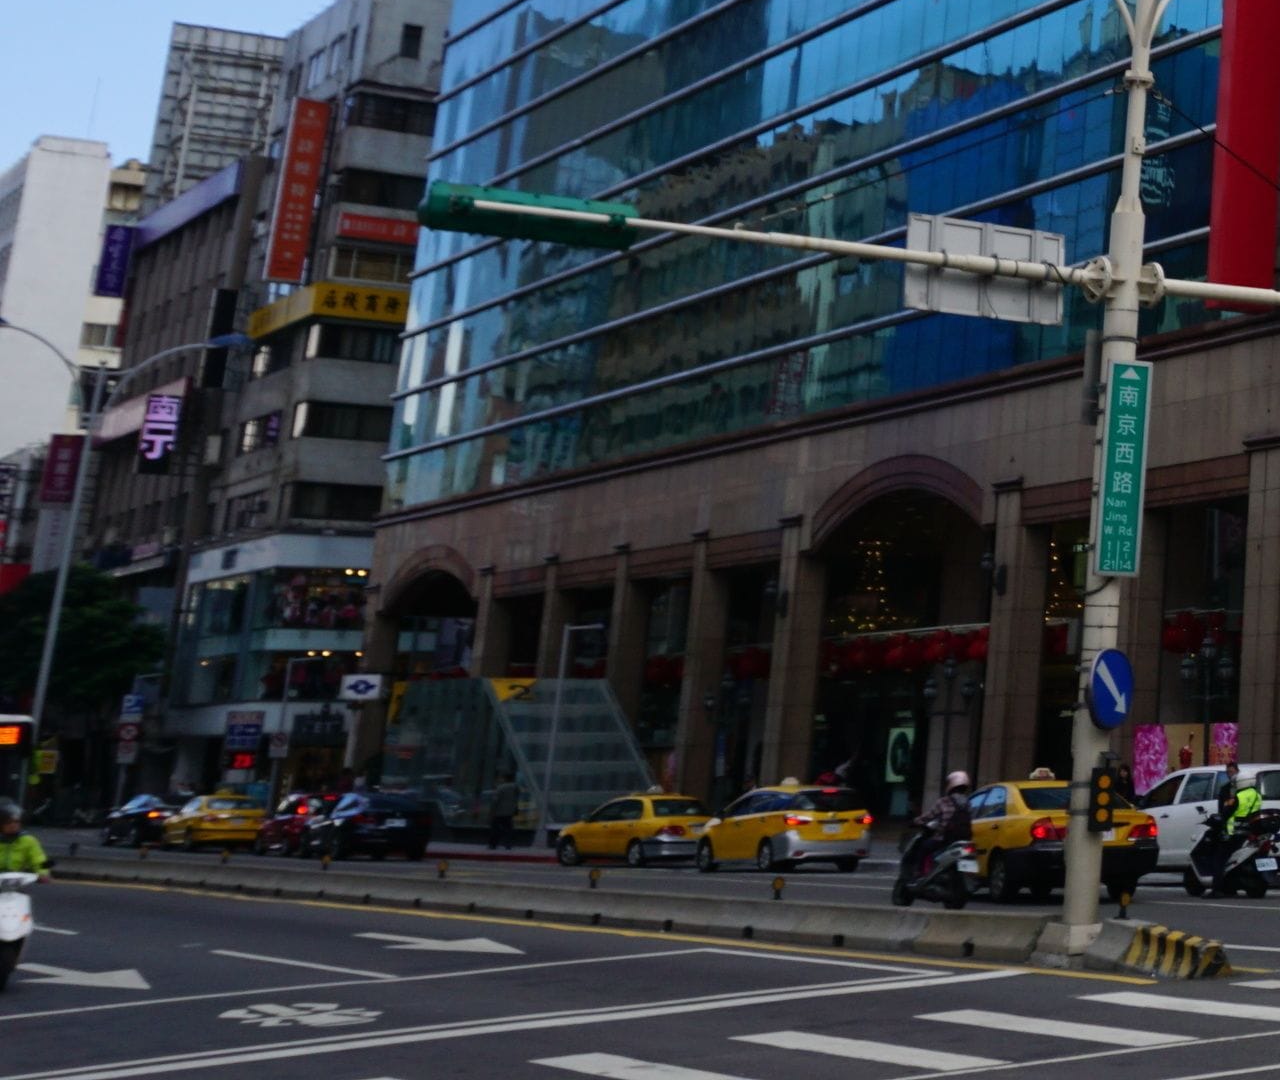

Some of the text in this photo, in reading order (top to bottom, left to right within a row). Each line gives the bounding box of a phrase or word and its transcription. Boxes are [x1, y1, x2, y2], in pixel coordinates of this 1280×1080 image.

[1112, 385, 1140, 494] 南京西路
[1105, 497, 1127, 508] Nan
[1105, 511, 1128, 525] Jing
